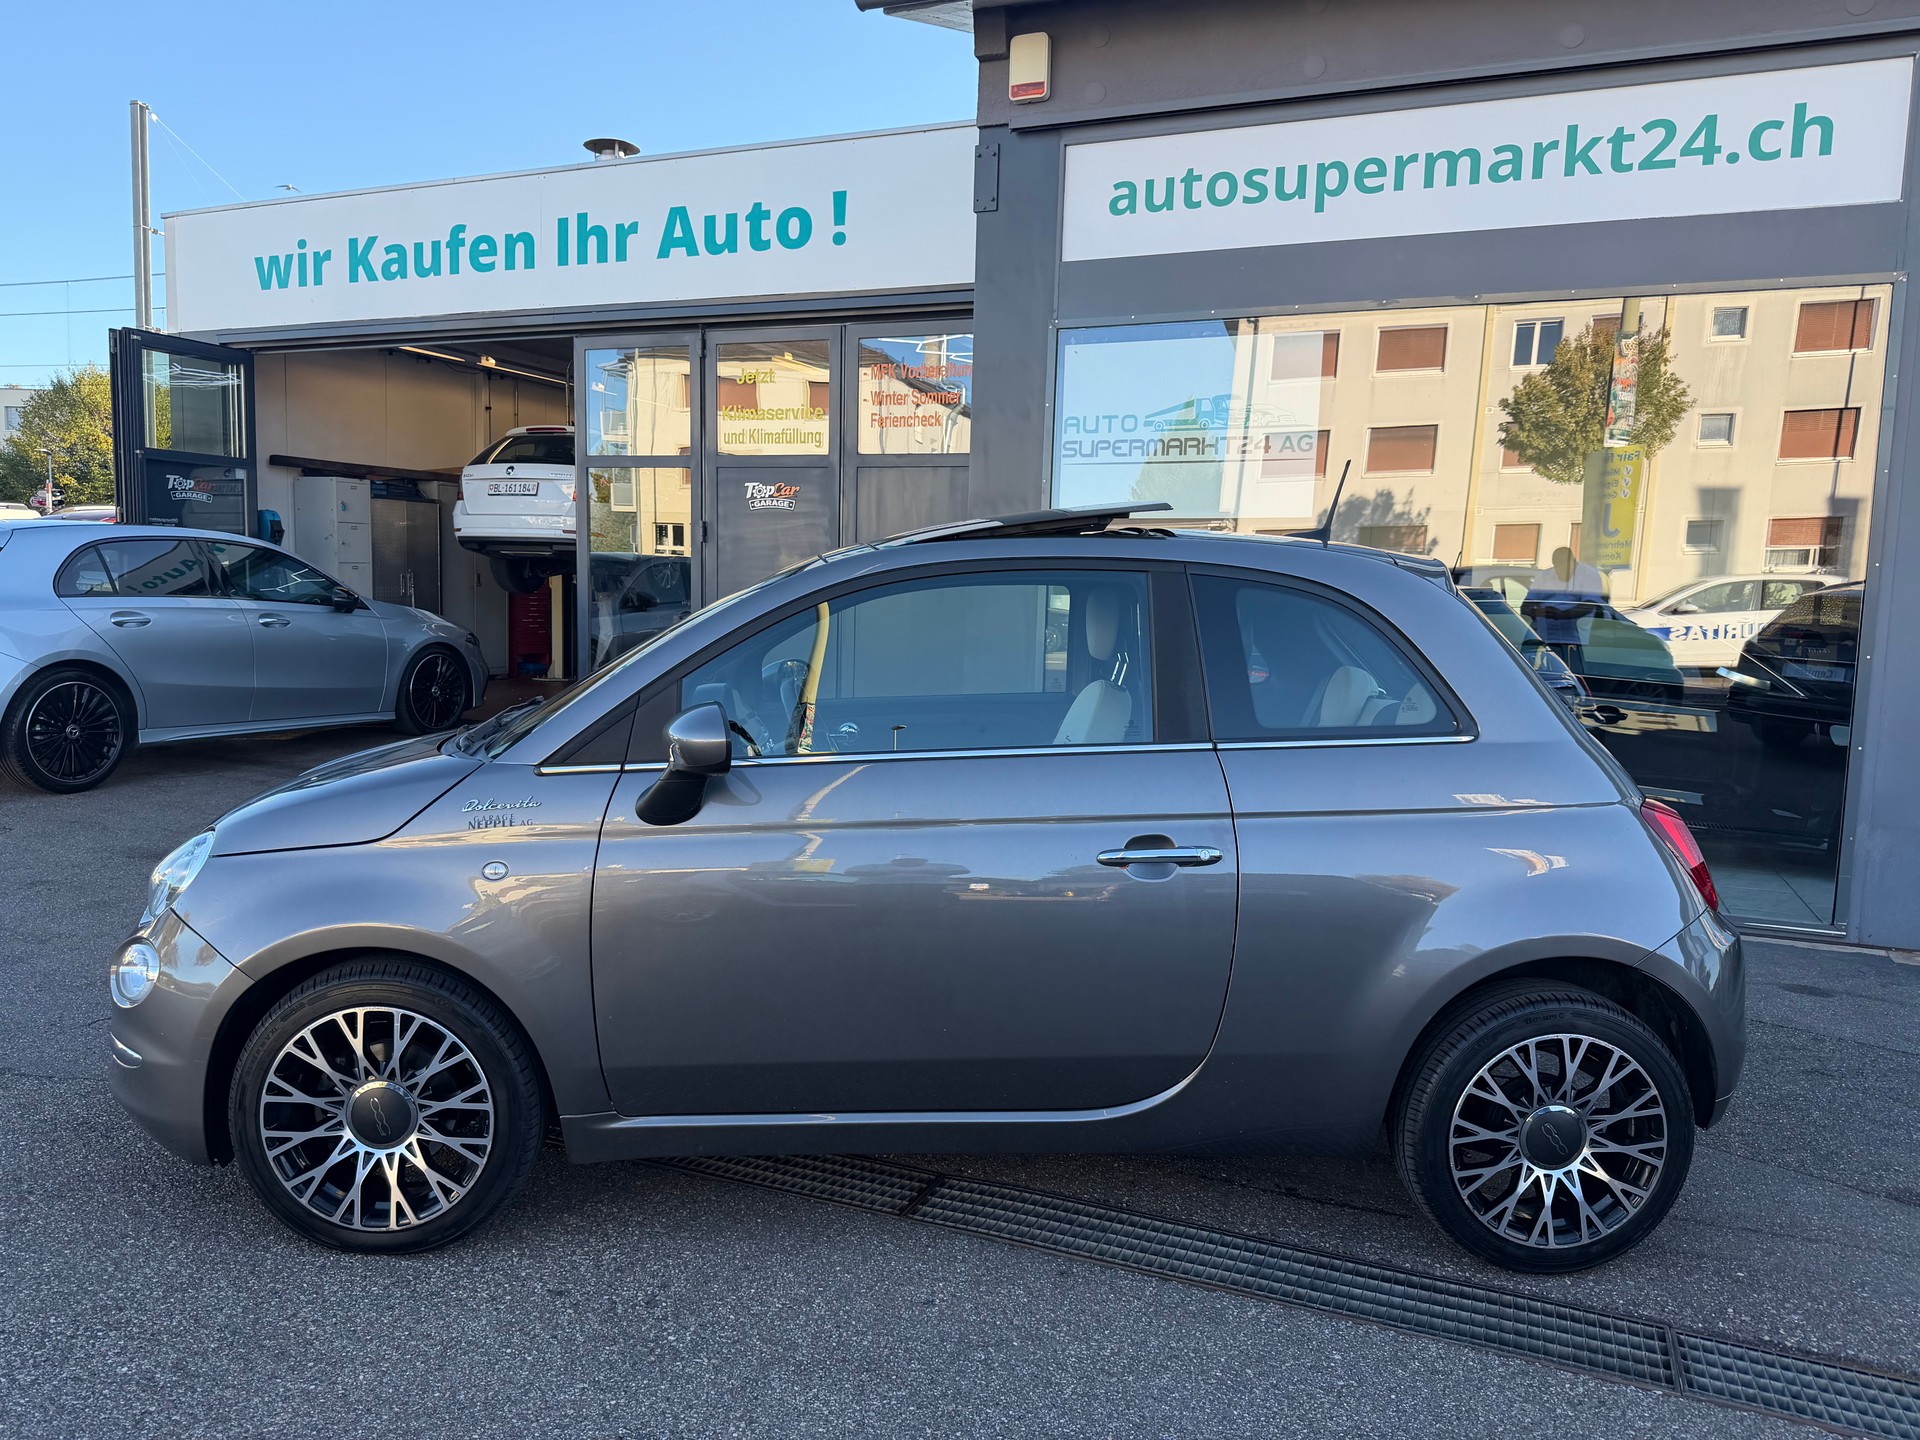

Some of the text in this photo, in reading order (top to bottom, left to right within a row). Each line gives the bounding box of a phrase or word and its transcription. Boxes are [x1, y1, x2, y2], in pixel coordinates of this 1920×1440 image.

[1108, 102, 1835, 217] autosupermarkt24.ch
[254, 238, 332, 291] wir
[348, 223, 536, 284] Kaufen
[557, 212, 639, 267] Ihr
[657, 201, 813, 260] Auto
[736, 368, 775, 385] Jetzt
[871, 361, 973, 380] MFK Vorbereitun
[871, 389, 961, 406] Winter Sommer
[722, 404, 824, 420] Klimaservice
[871, 411, 942, 429] Feriencheck
[1063, 414, 1138, 435] AUTO
[723, 427, 822, 448] und Klimafüllung
[1278, 434, 1314, 453] AG
[175, 492, 208, 500] GARAGE
[754, 500, 790, 508] GARAGE
[462, 796, 542, 813] Dolcevita
[473, 813, 516, 823] GARAGE
[520, 818, 534, 826] AG
